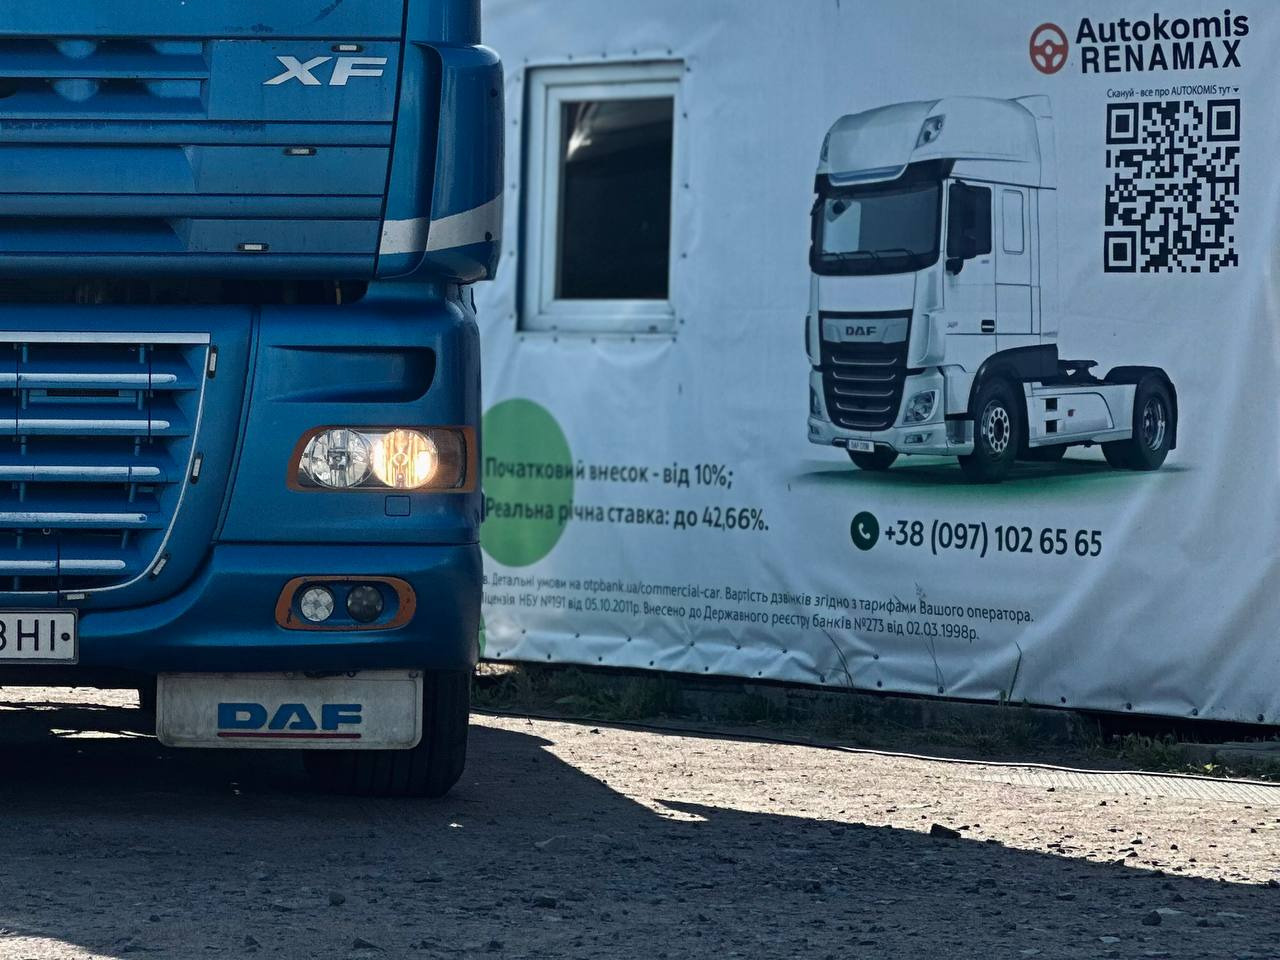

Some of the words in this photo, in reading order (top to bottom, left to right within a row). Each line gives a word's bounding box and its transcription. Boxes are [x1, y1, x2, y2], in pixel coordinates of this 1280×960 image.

[1075, 9, 1250, 44] Autokomis
[263, 56, 388, 86] XF
[1081, 40, 1242, 74] RENAMAX
[1106, 88, 1135, 100] Скануй
[1140, 88, 1154, 98] все
[1154, 87, 1170, 98] про
[1171, 85, 1217, 96] AUTOKOMIS
[1218, 86, 1231, 97] тут
[845, 326, 877, 336] DAF
[485, 457, 585, 481] Початковий
[589, 464, 649, 483] внесок
[663, 461, 690, 488] від
[695, 463, 734, 489] 10%;
[485, 497, 554, 520] Реальна
[558, 499, 606, 526] річна
[607, 505, 669, 525] ставка:
[673, 509, 698, 530] до
[702, 505, 769, 532] 42,66%.
[884, 520, 924, 547] +38
[931, 519, 988, 558] (097)
[994, 525, 1033, 554] 102
[1039, 527, 1068, 556] 65
[1074, 529, 1103, 557] 65
[493, 572, 535, 587] Детальні
[537, 578, 567, 591] умови
[569, 580, 581, 590] на
[725, 587, 769, 604] Вартість
[814, 595, 850, 610] згідно
[851, 599, 857, 609] з
[859, 598, 917, 616] тарифами
[919, 600, 964, 617] Вашого
[966, 606, 1035, 624] оператора.
[519, 593, 539, 608] НБУ
[568, 596, 583, 611] від
[643, 601, 686, 617] Внесено
[688, 607, 702, 620] до
[703, 605, 769, 623] Державного
[771, 613, 810, 630] реєстру
[812, 614, 852, 630] банків
[854, 617, 885, 633] №273
[887, 620, 904, 636] від
[906, 621, 980, 643] 02.03.1998р.
[16, 619, 56, 652] HI
[217, 702, 362, 731] DAF
